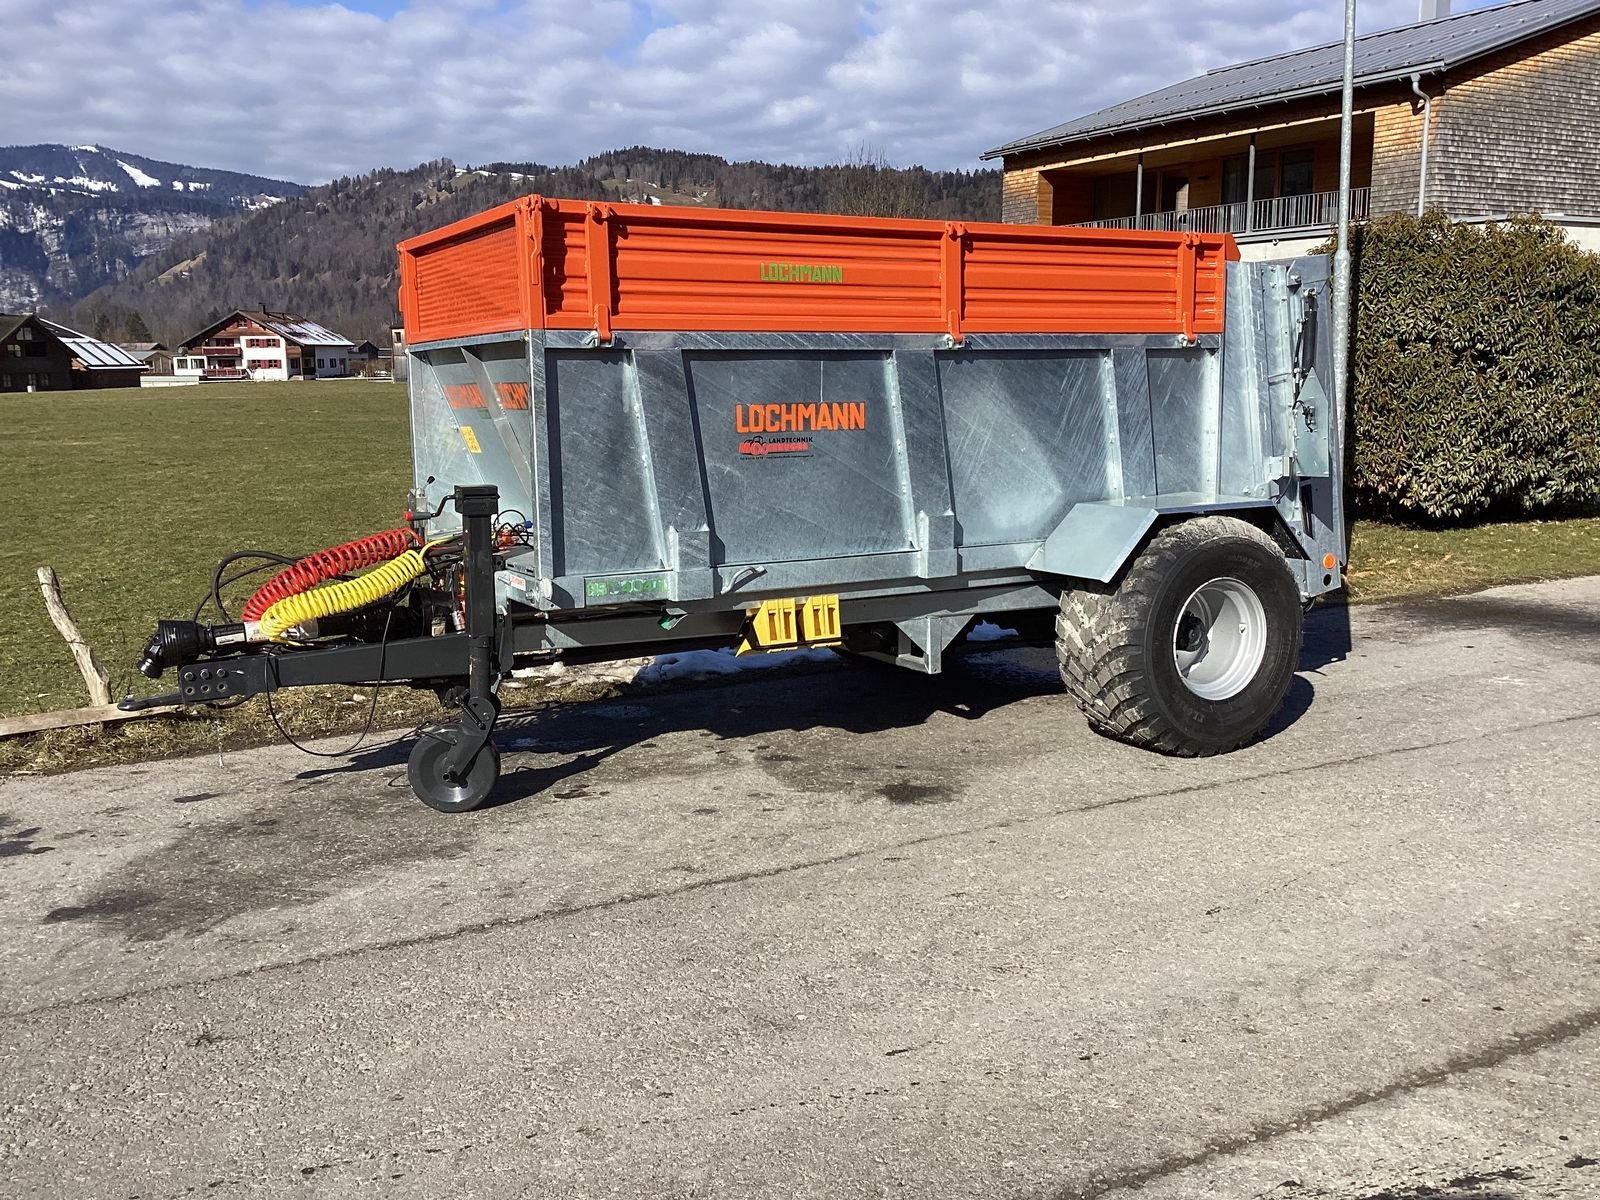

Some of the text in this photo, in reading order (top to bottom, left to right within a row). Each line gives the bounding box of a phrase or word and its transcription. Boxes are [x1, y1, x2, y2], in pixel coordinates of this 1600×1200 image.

[760, 262, 844, 284] LOCHMANN
[735, 402, 866, 433] LOCHMANN
[768, 436, 814, 444] LANDTECHNIK
